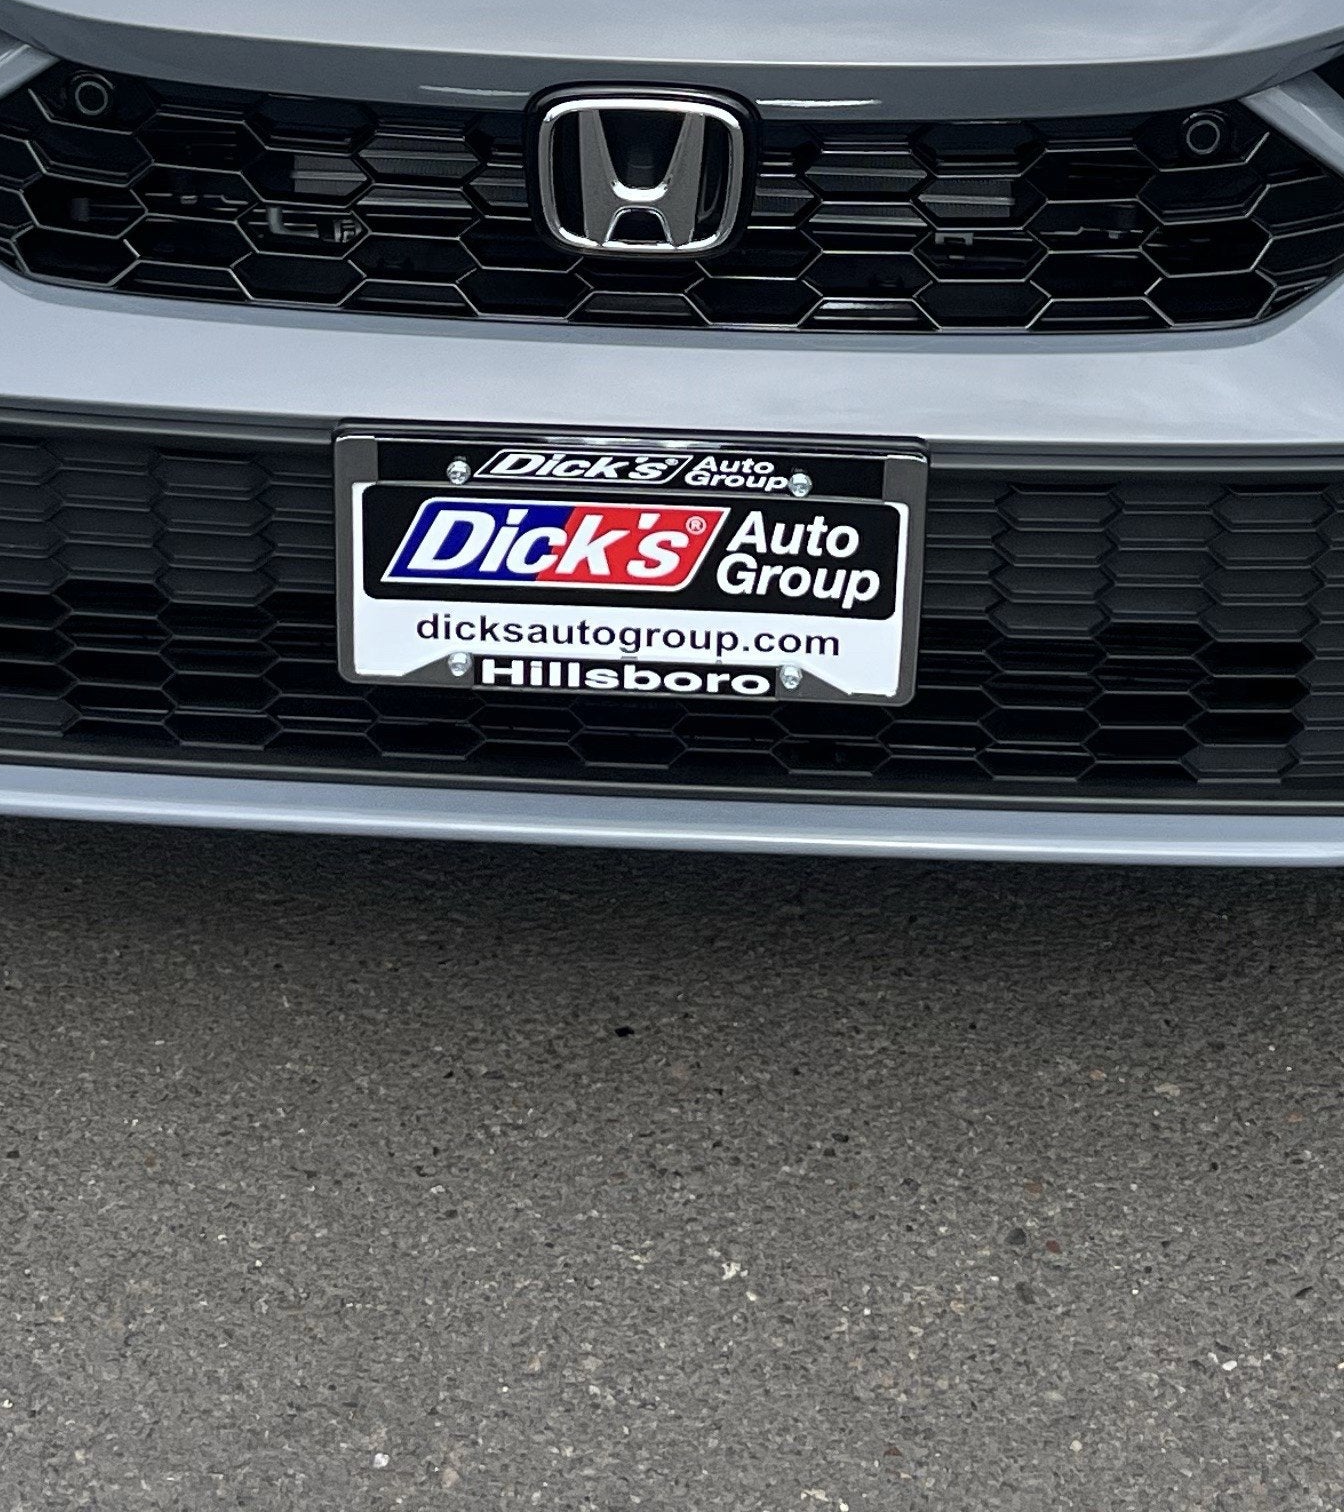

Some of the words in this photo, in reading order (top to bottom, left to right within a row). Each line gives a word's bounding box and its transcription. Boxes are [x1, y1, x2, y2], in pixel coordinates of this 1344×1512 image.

[684, 469, 789, 491] Group
[690, 455, 775, 475] Auto
[726, 510, 860, 558] Auto
[716, 552, 881, 610] Group
[416, 613, 839, 656] dicksautogroup.com
[481, 658, 771, 696] Hillsboro
